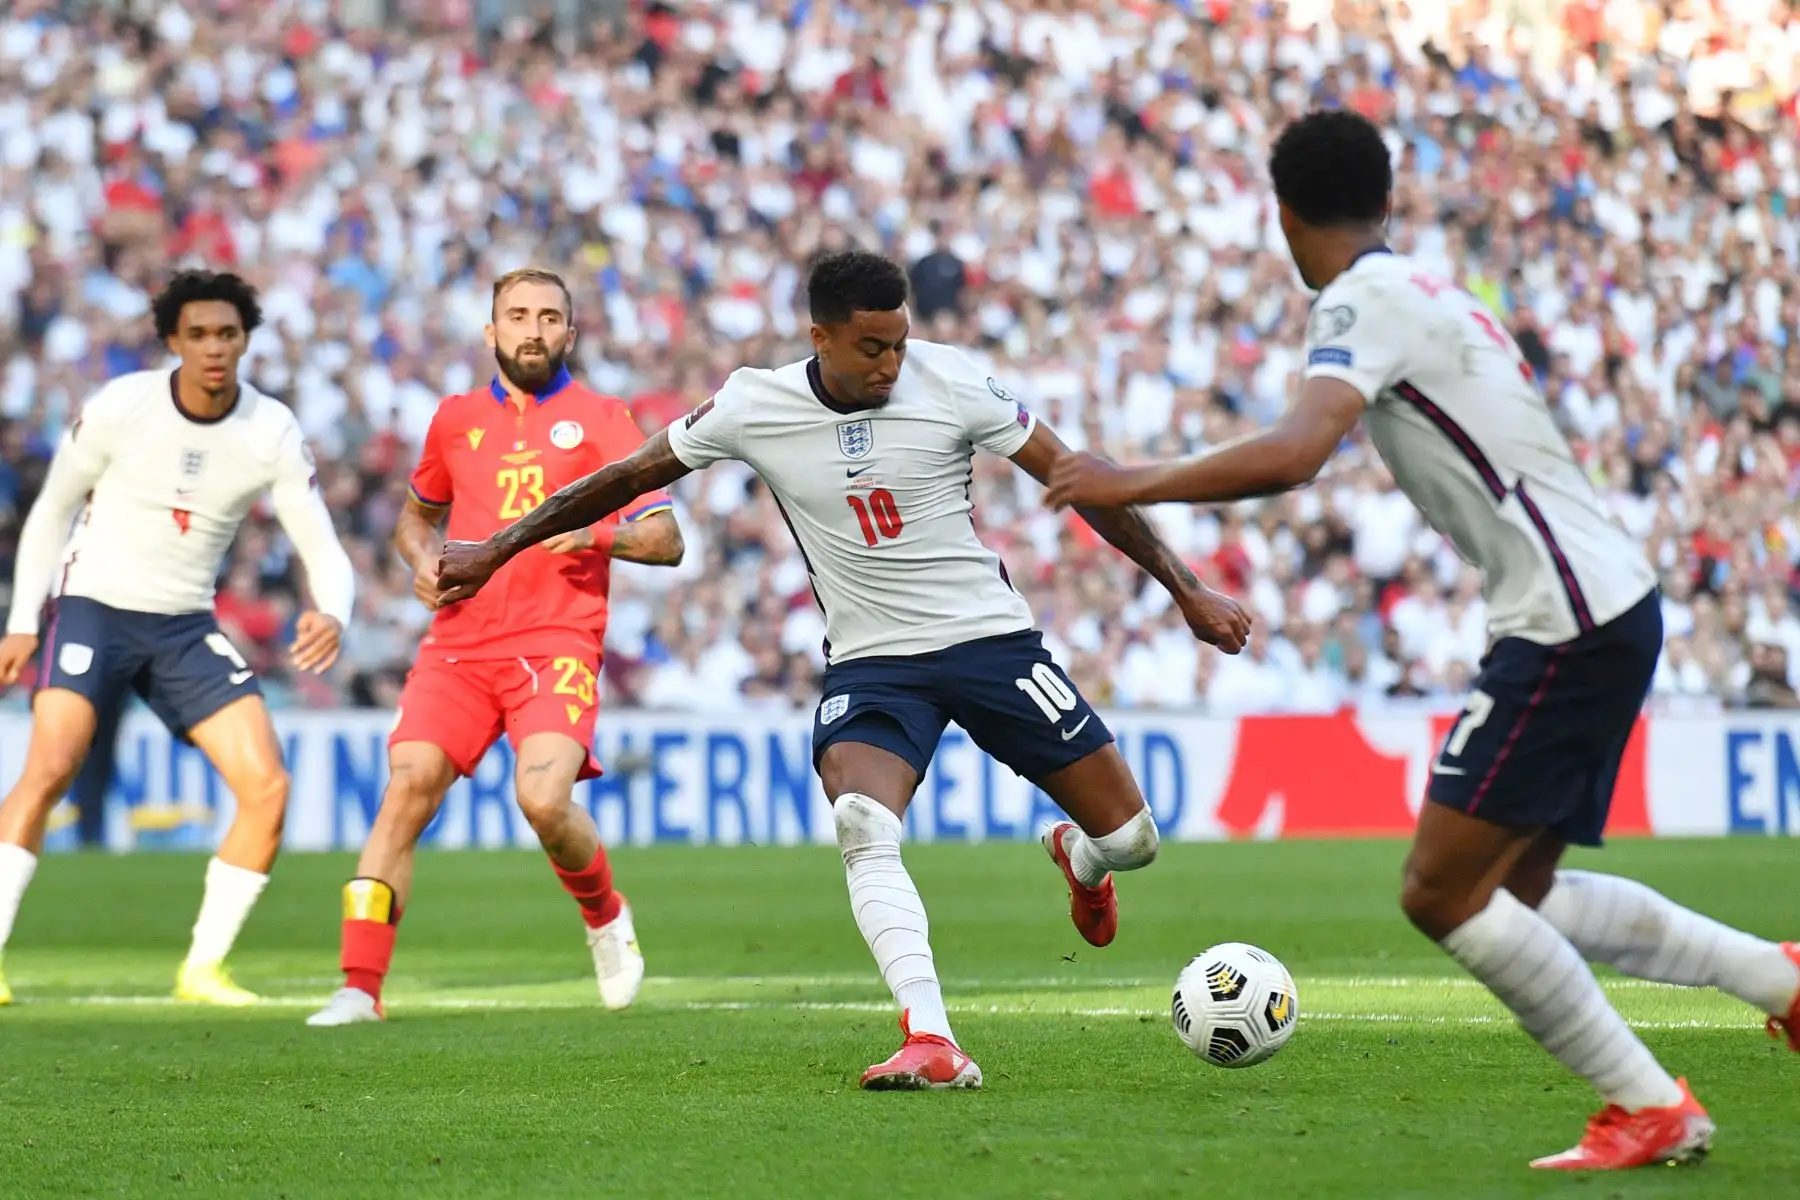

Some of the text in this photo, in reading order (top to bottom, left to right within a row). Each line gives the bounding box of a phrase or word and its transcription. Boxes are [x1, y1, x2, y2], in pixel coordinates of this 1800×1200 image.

[497, 465, 546, 520] 23
[846, 488, 904, 548] 10
[1015, 662, 1077, 724] 10
[333, 733, 813, 843] NRHERN
